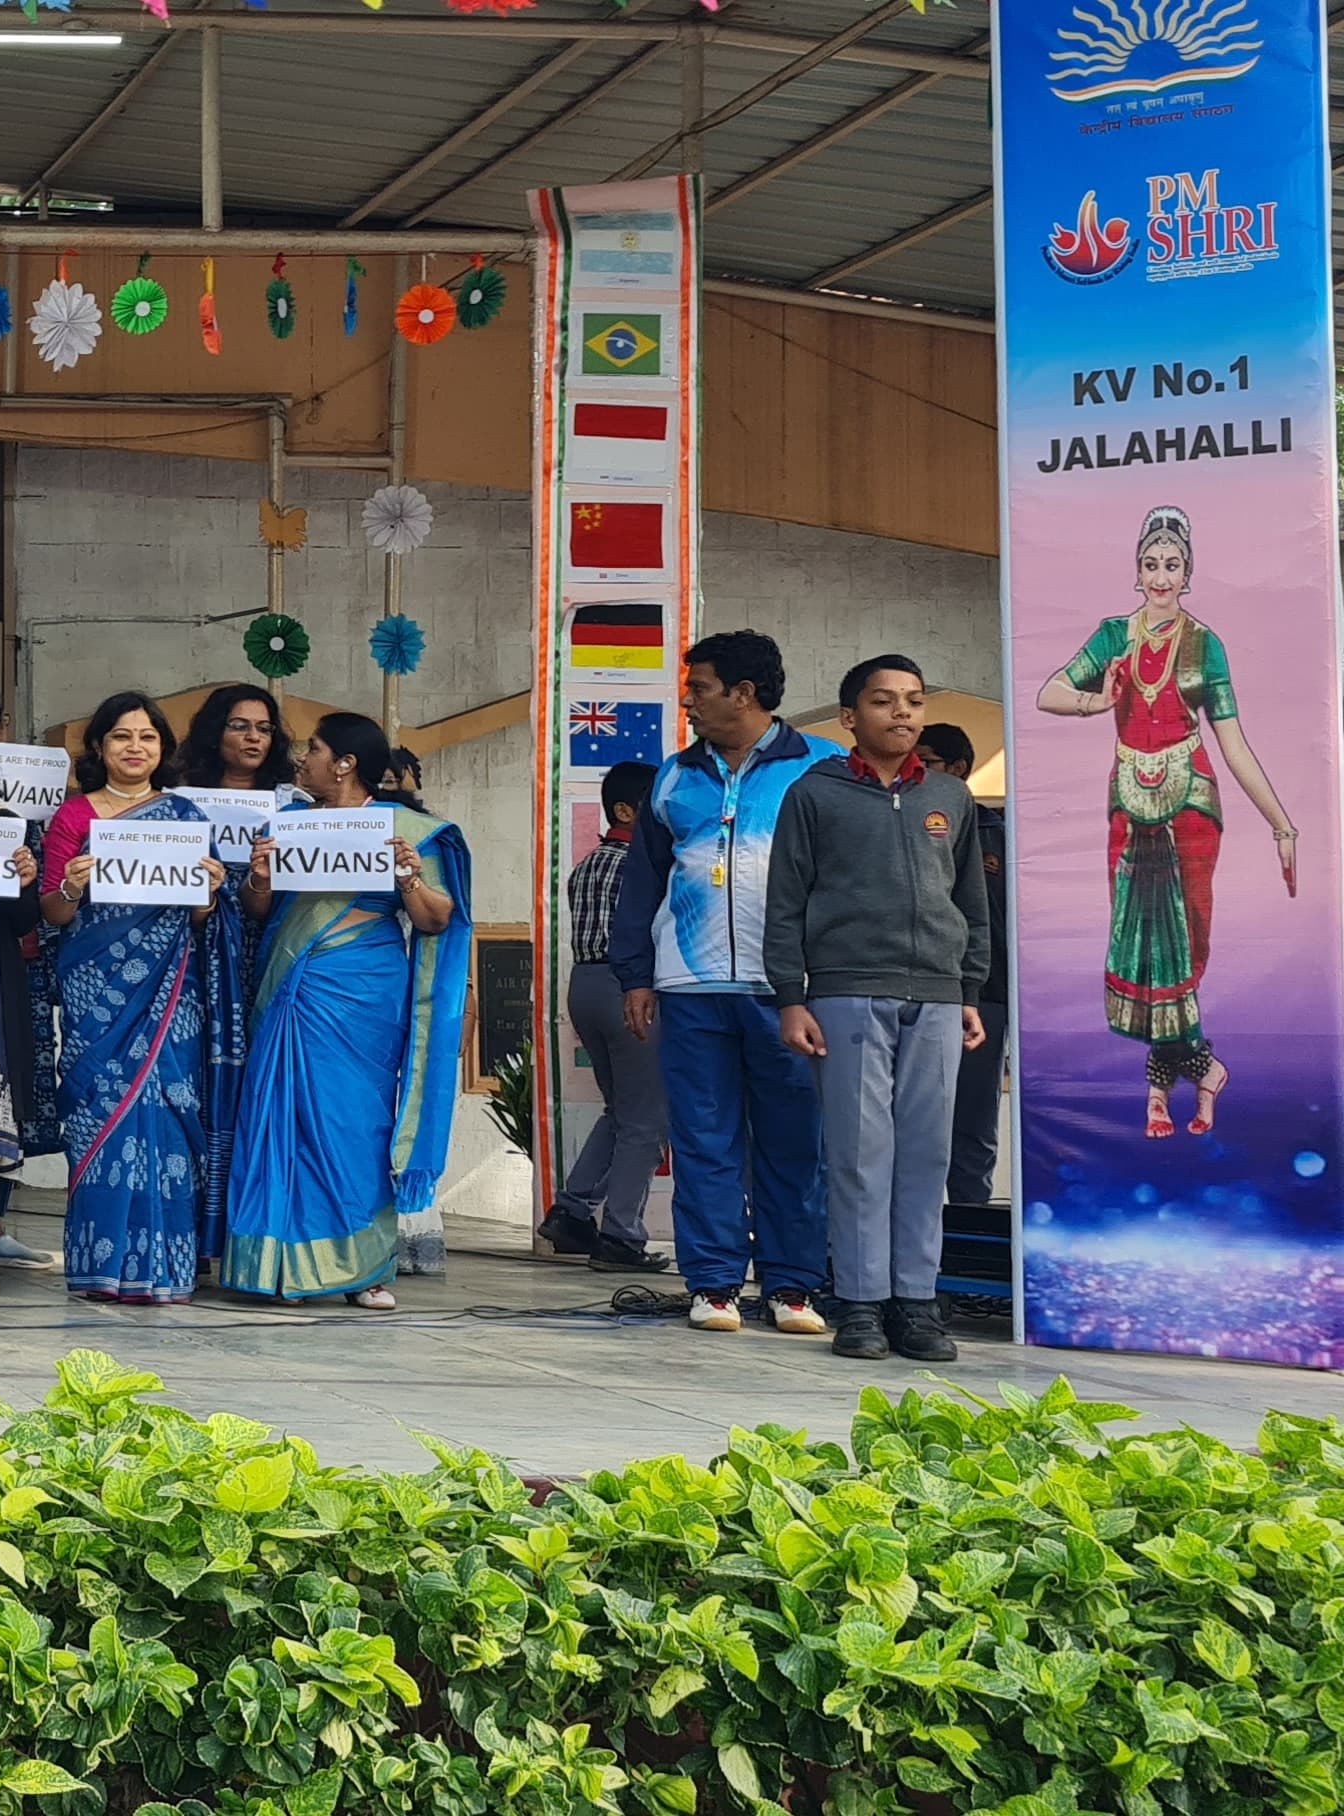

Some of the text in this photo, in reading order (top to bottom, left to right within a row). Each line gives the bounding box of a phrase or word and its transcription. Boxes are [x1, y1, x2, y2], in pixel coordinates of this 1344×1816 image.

[1147, 170, 1219, 215] PM
[1148, 203, 1277, 262] SHRI
[1073, 355, 1249, 406] KV No.1
[1037, 417, 1292, 473] JALAHALLI
[212, 797, 232, 805] THE
[235, 798, 270, 808] PROUD
[99, 832, 203, 844] WE ARE THE PROUD
[277, 821, 385, 831] WE ARE THE PROUD
